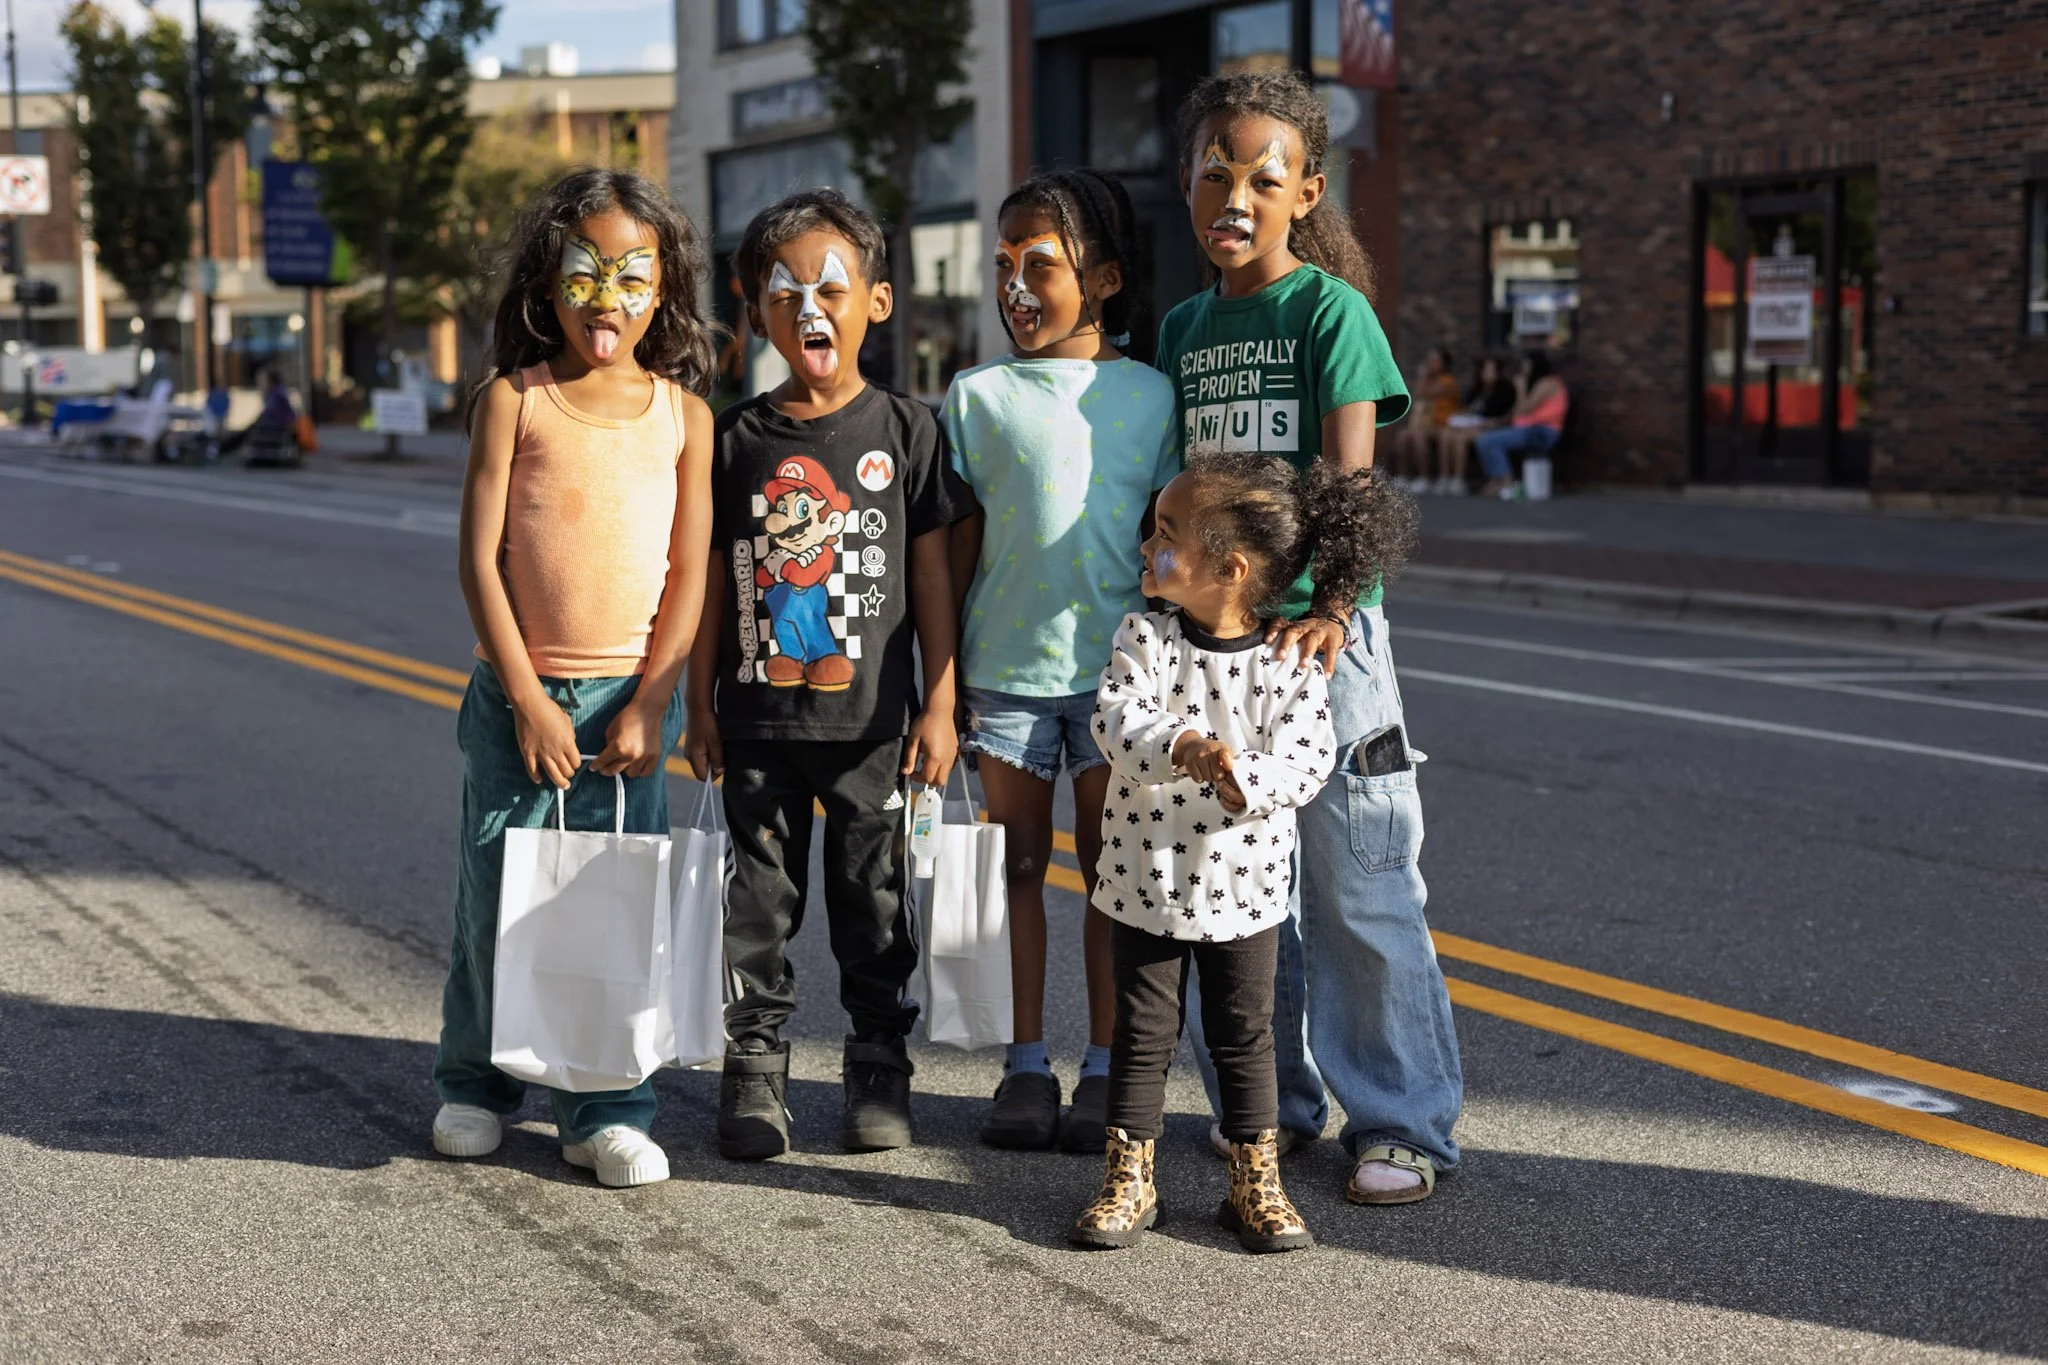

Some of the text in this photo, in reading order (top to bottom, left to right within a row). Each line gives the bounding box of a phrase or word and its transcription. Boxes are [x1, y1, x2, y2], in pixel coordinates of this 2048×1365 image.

[1180, 339, 1297, 378] SCIENTIFICALLY
[1198, 369, 1261, 401] PROVEN
[783, 465, 801, 478] M
[860, 457, 892, 482] M
